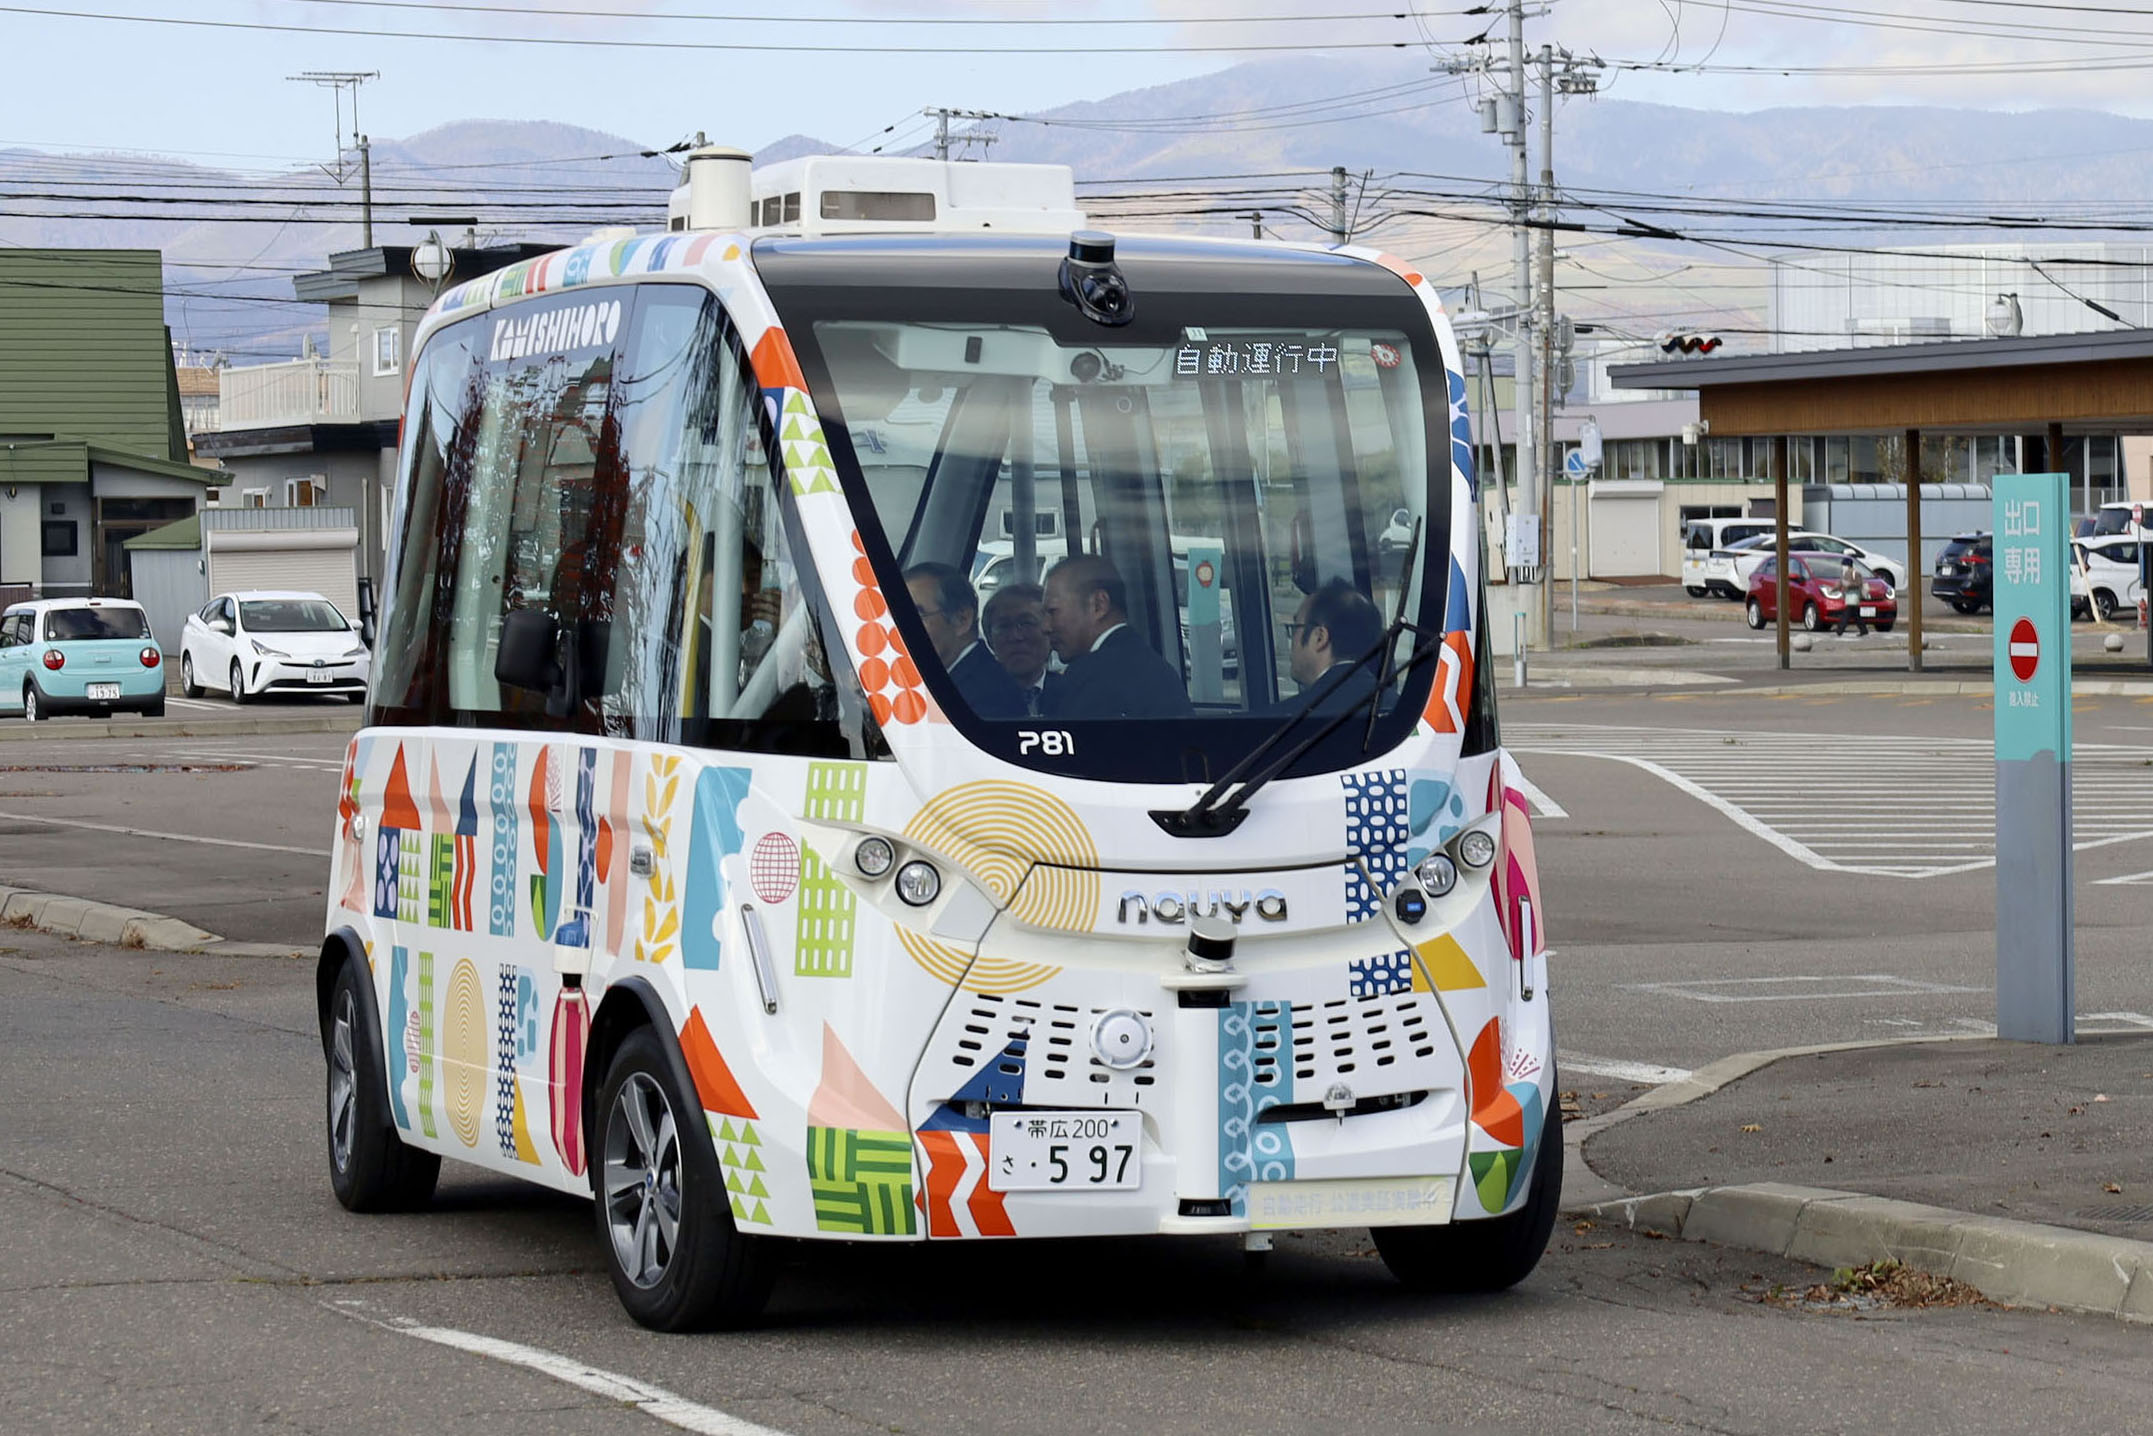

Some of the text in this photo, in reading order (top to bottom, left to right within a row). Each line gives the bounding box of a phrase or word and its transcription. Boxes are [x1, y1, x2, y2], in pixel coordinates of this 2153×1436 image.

[490, 299, 621, 361] KAMISHIHORO
[1177, 342, 1337, 374] 自動運行中
[2004, 499, 2040, 536] 出口
[2003, 547, 2041, 584] 専用
[1018, 730, 1075, 755] P81
